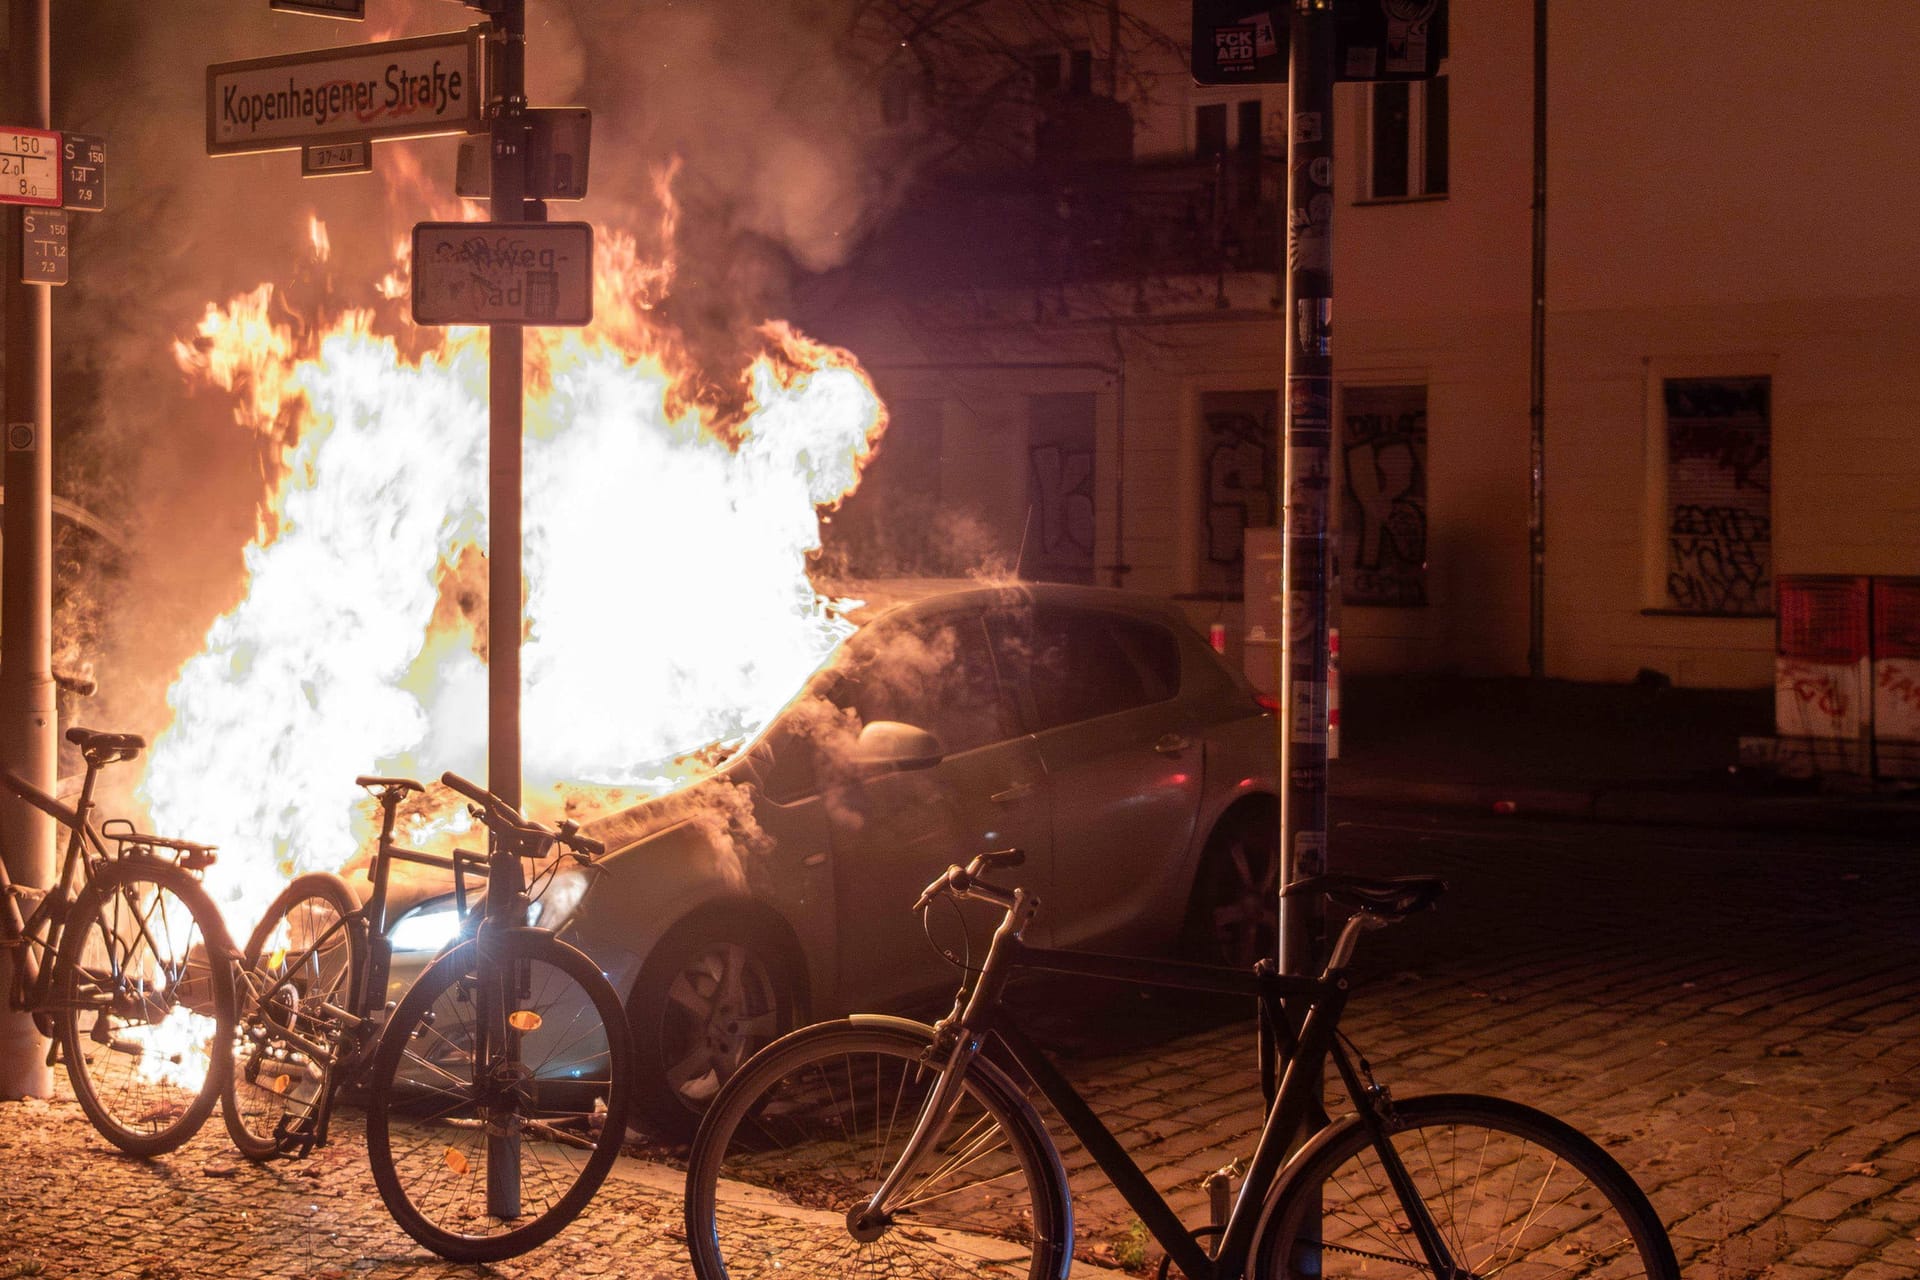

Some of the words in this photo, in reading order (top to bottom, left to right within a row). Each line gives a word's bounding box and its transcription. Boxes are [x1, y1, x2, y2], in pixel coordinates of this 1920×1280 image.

[1216, 32, 1252, 47] FCK
[1217, 46, 1253, 60] AFD
[223, 78, 377, 132] Kopenhagener
[385, 60, 463, 115] Straße
[12, 136, 40, 154] 150
[65, 143, 75, 160] S
[88, 151, 104, 163] 150
[24, 216, 35, 233] S
[50, 224, 66, 236] 150
